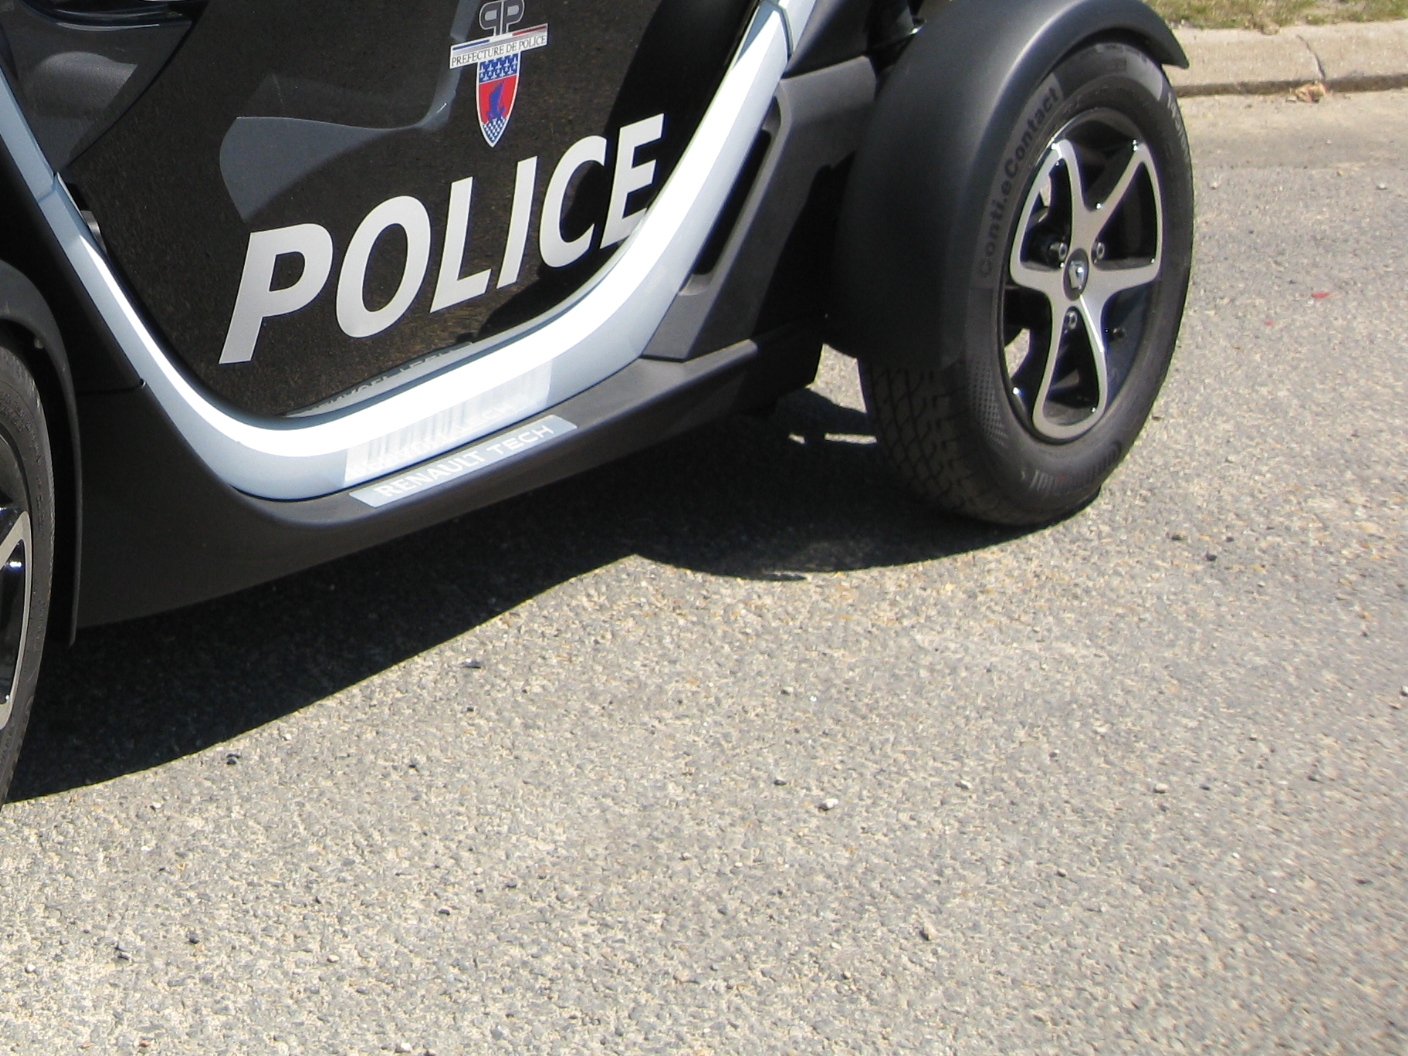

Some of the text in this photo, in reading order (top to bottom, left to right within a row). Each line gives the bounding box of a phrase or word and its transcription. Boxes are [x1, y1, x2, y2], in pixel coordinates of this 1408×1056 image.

[451, 35, 546, 67] PREFECTURE DE POLICE
[219, 113, 665, 365] POLICE
[373, 450, 489, 497] RENAULT
[486, 424, 555, 457] TECH
